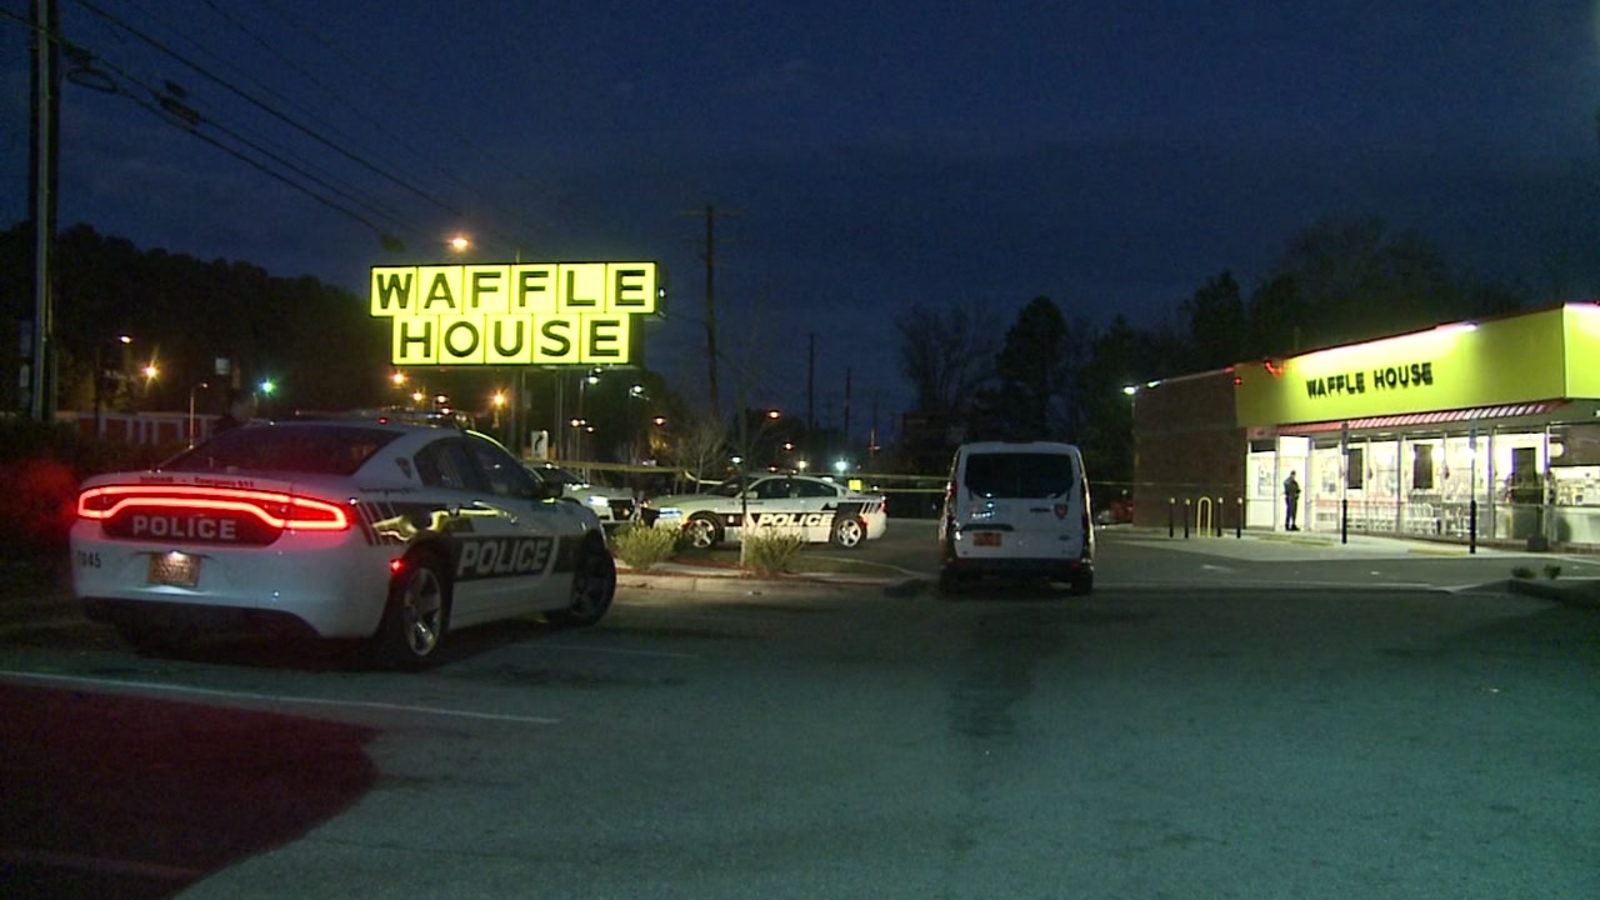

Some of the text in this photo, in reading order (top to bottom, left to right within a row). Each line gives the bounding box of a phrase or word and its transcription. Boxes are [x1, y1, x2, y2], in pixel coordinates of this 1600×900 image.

[376, 269, 646, 309] WAFFLE
[400, 320, 620, 358] HOUSE
[1306, 362, 1433, 399] WAFFLE HOUSE
[132, 515, 236, 539] POLICE
[757, 513, 836, 527] POLICE
[456, 539, 549, 577] POLICE
